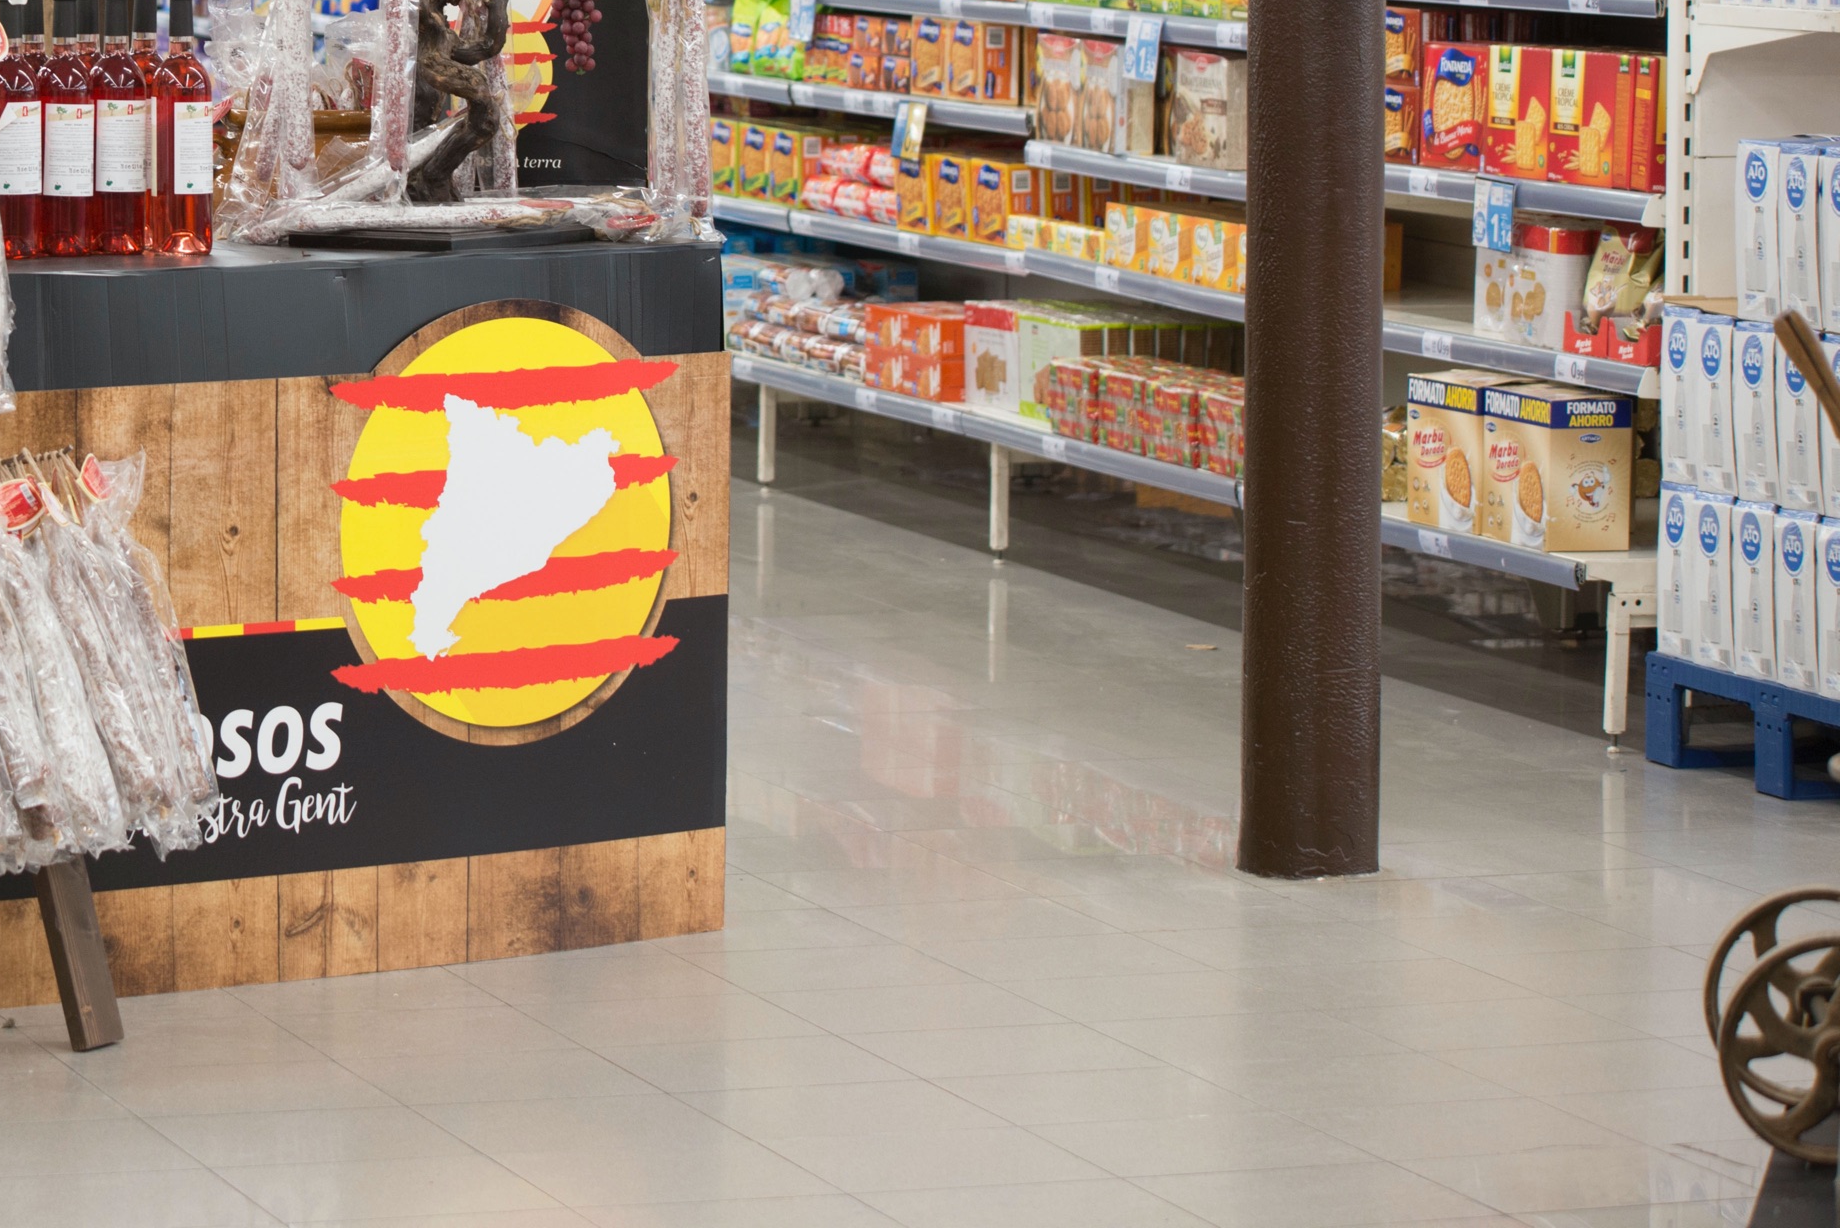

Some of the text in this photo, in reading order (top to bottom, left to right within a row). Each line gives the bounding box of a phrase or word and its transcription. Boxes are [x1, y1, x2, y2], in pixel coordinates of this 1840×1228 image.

[1440, 57, 1473, 73] FONTANEDA
[524, 156, 562, 169] terra
[1747, 161, 1766, 180] ATO
[1788, 171, 1806, 190] ATO
[1669, 333, 1686, 351] ATO
[1703, 340, 1719, 358] ATO
[1744, 348, 1761, 367] ATO
[1408, 378, 1477, 412] FORMATO AHORRO
[1485, 390, 1551, 424] FORMATO AHORRO
[1566, 401, 1616, 415] FORMATO
[1569, 414, 1613, 427] AHORRO
[1667, 507, 1683, 526] ATO
[1700, 517, 1718, 537] ATO
[1742, 524, 1759, 543] ATO
[1784, 535, 1801, 555] ATO
[275, 776, 357, 835] Gent
